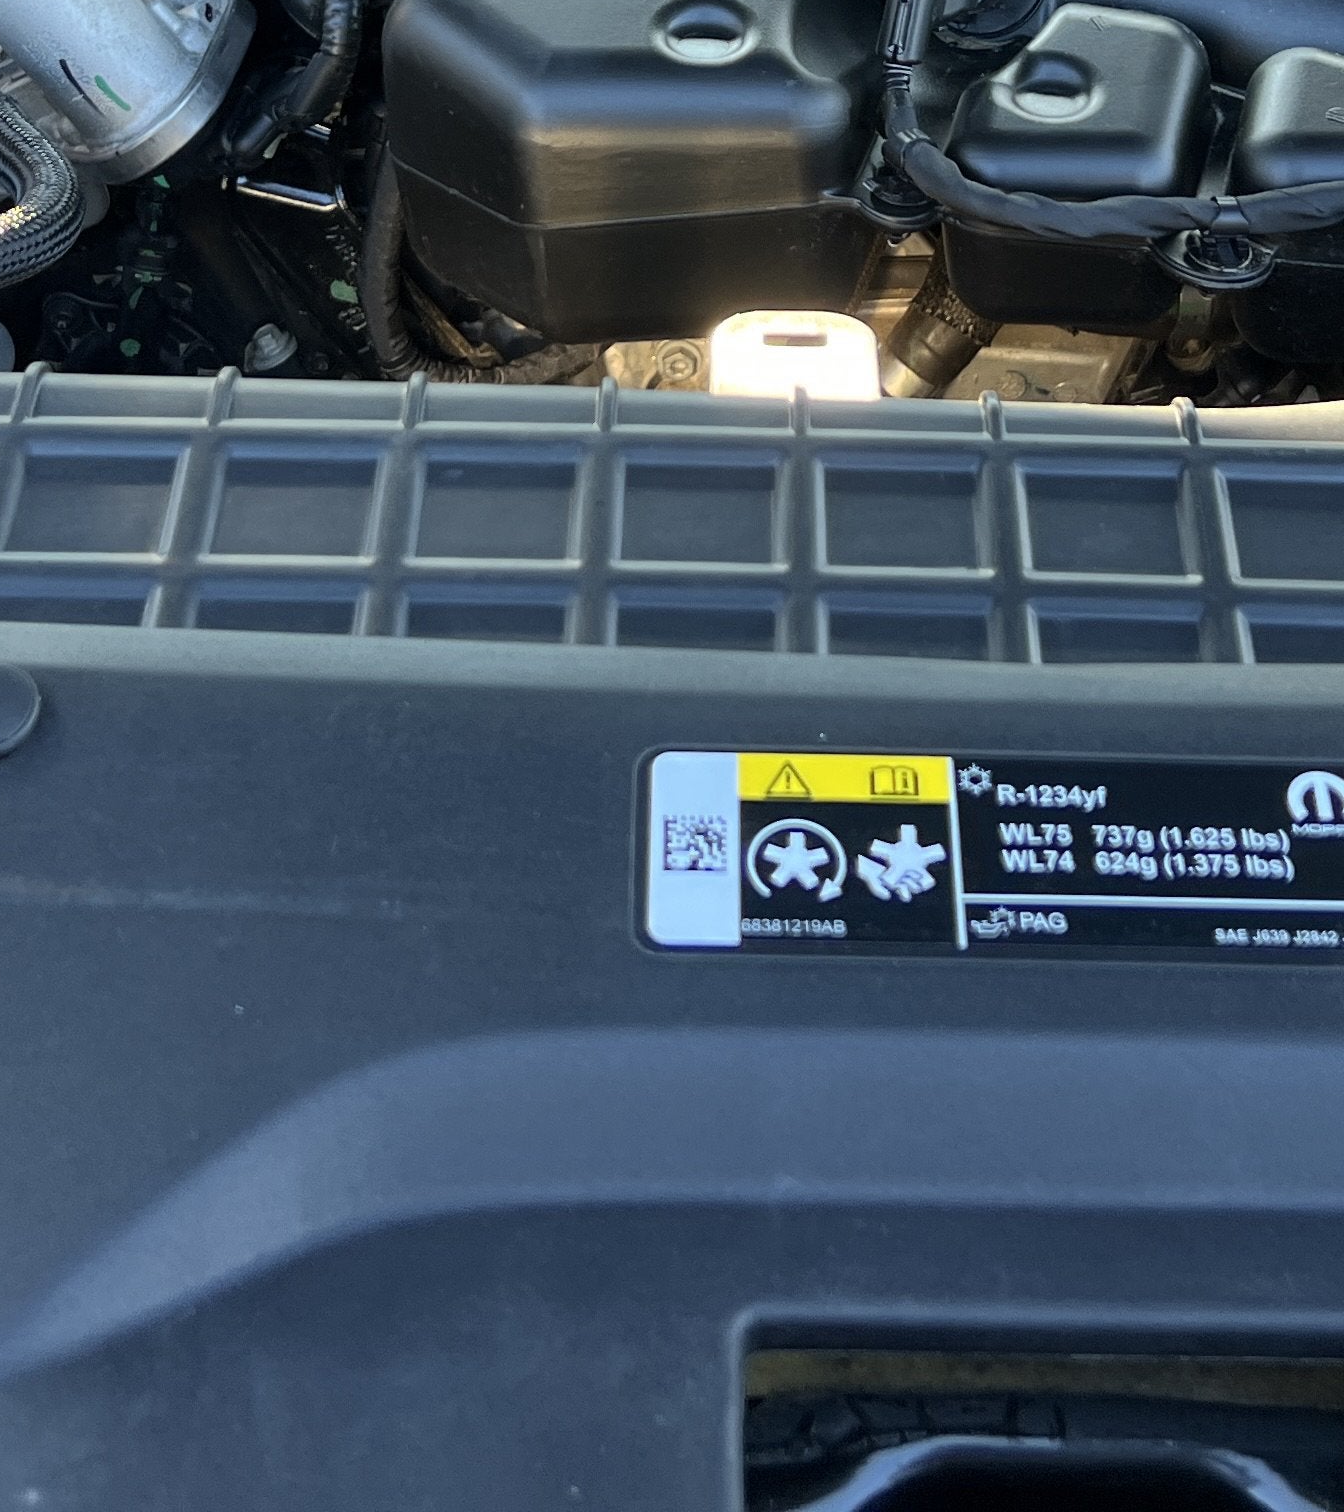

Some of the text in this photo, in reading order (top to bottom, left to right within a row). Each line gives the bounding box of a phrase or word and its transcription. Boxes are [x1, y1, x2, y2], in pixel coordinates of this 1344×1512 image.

[996, 783, 1107, 813] R-1234yf
[998, 822, 1291, 855] WL75 737g (1.625 lbs)
[1001, 848, 1296, 884] WL74 624g (1.375 lbs)
[741, 917, 848, 938] 68381219AB
[1019, 911, 1070, 935] PAG
[1215, 927, 1250, 946] SAE
